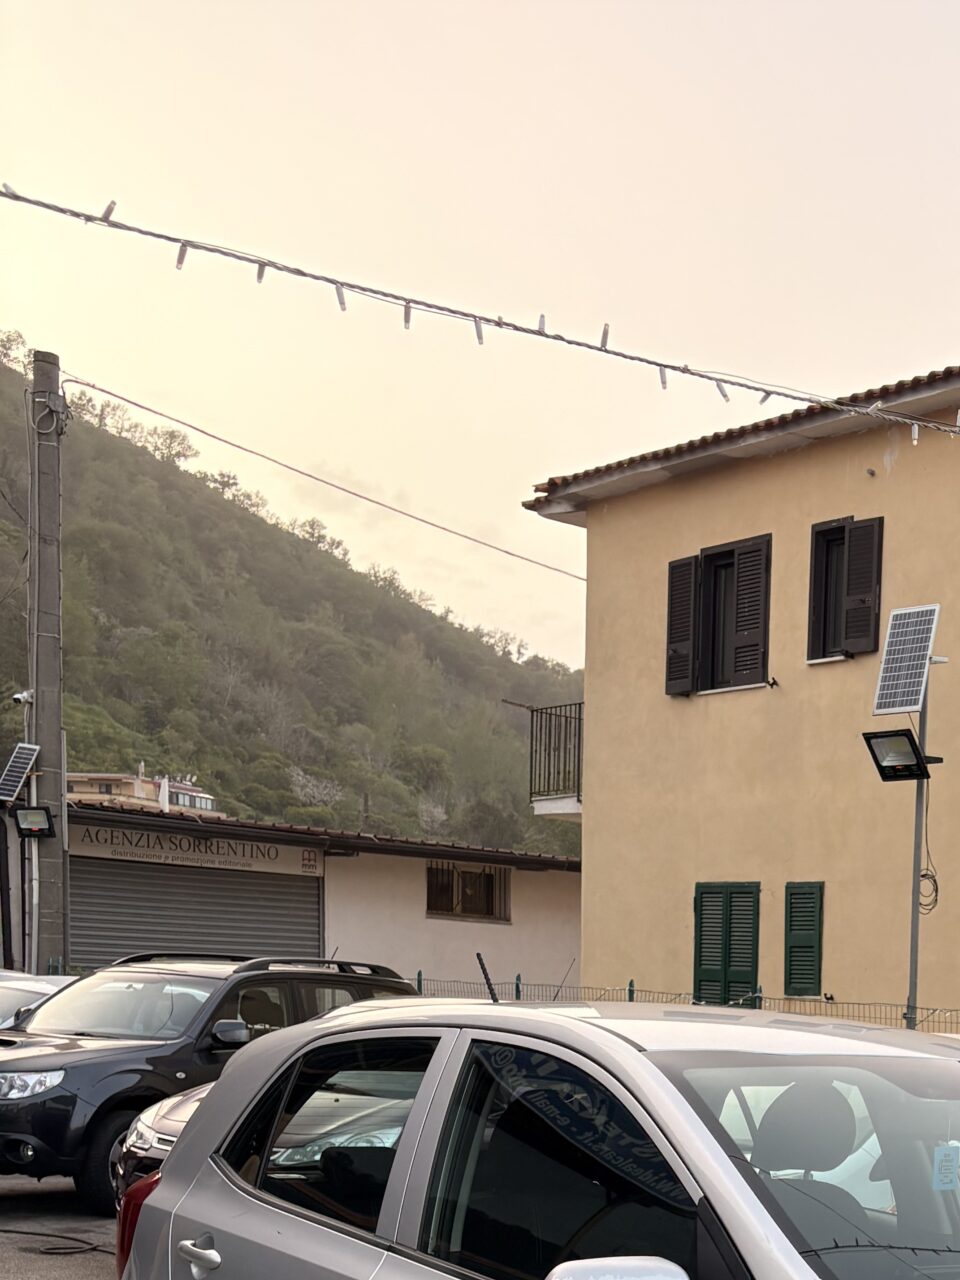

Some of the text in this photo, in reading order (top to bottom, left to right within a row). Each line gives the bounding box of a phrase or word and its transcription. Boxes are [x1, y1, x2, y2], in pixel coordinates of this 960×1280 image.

[81, 827, 279, 860] AGENZIA SORRENTINO
[111, 849, 162, 861] distribuzione
[171, 855, 216, 866] promozione
[218, 859, 253, 869] editoriale
